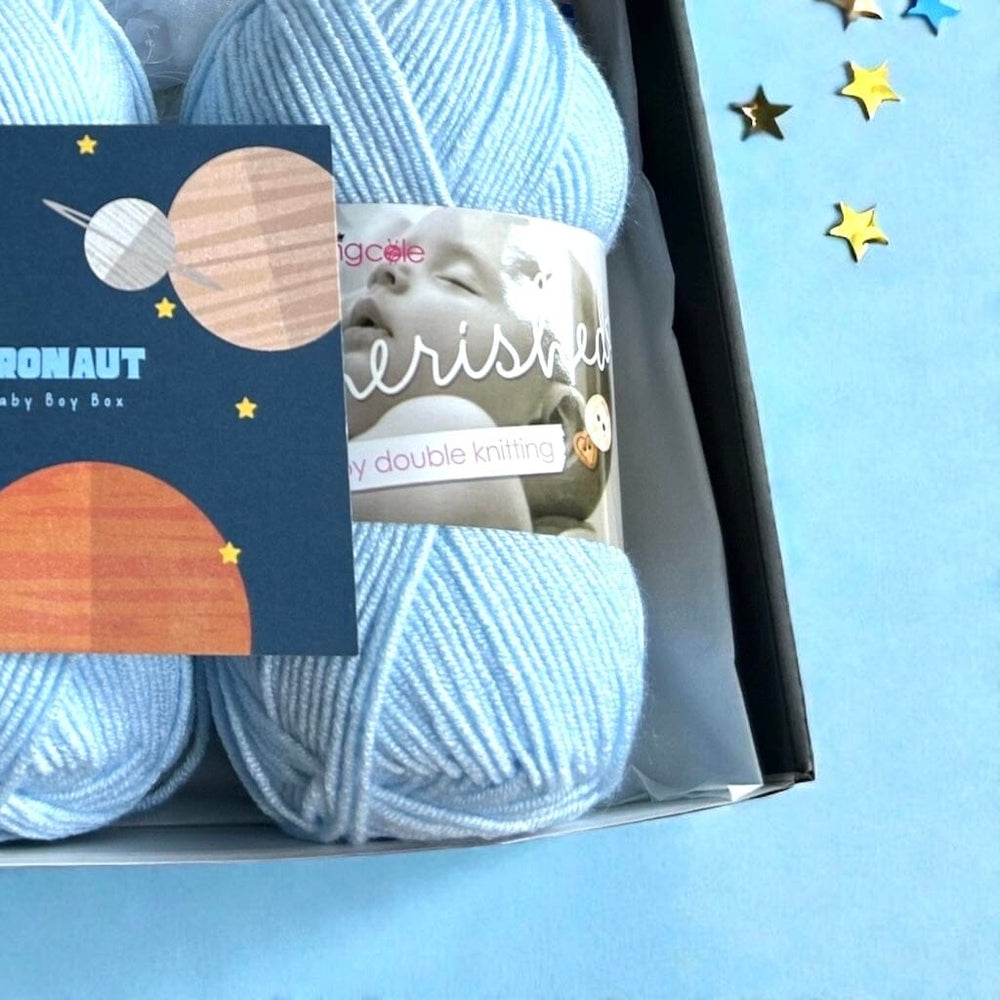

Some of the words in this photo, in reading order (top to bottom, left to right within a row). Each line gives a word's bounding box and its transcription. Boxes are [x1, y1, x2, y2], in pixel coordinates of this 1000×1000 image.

[45, 392, 79, 412] Boy
[90, 392, 124, 408] Box
[374, 444, 466, 474] double
[473, 438, 555, 466] knitting
